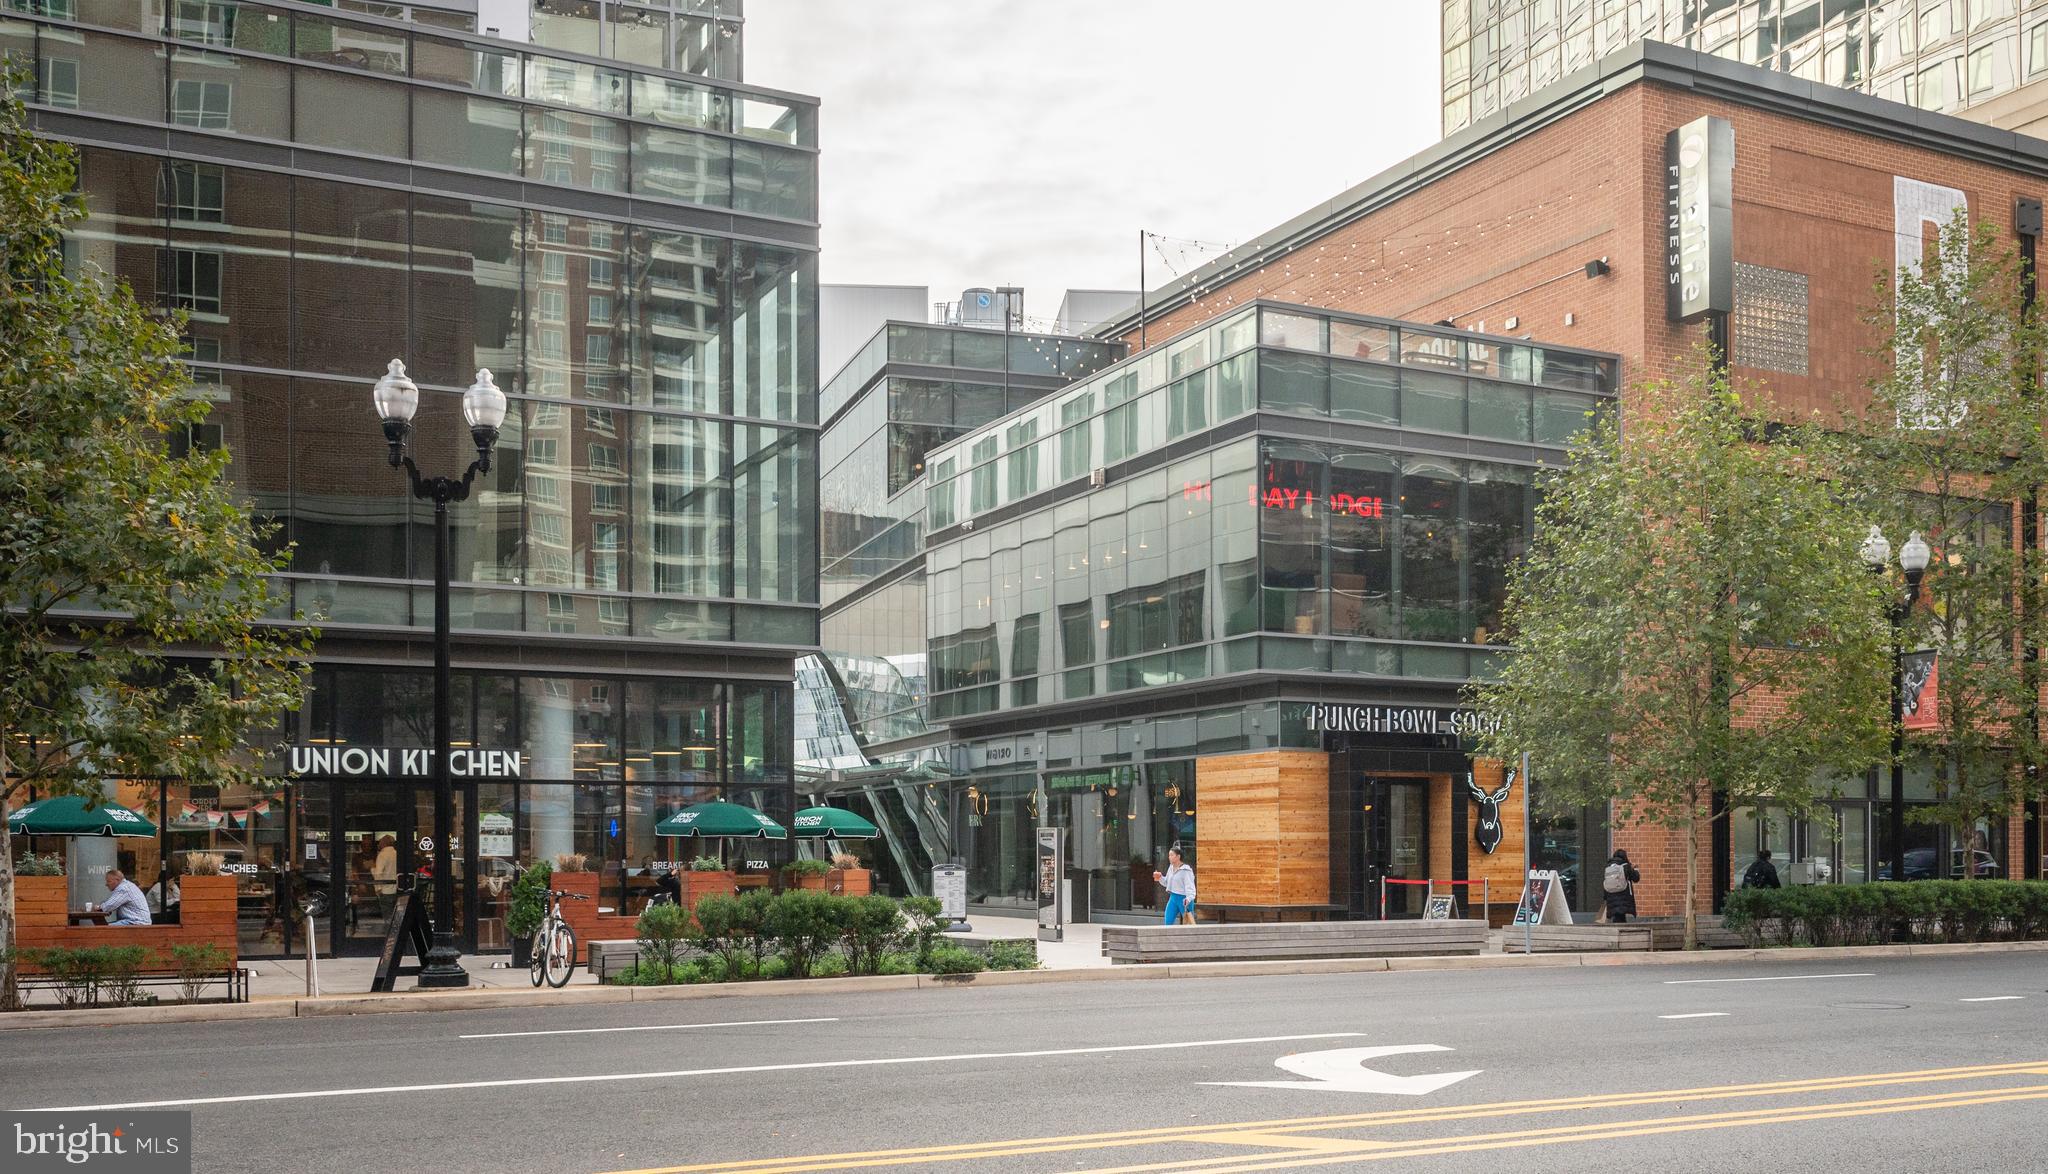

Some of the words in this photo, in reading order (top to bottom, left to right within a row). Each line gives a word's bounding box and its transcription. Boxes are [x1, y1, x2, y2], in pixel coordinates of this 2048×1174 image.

[1669, 165, 1680, 284] FITNESS
[1183, 480, 1299, 510] HDAY
[1306, 489, 1383, 519] LDGE
[1311, 705, 1379, 731] PUNCH
[1386, 708, 1446, 733] BOWL
[1450, 711, 1504, 735] SOC
[292, 747, 389, 774] UNION
[402, 749, 520, 776] KICHEN
[746, 860, 769, 869] PIZZA
